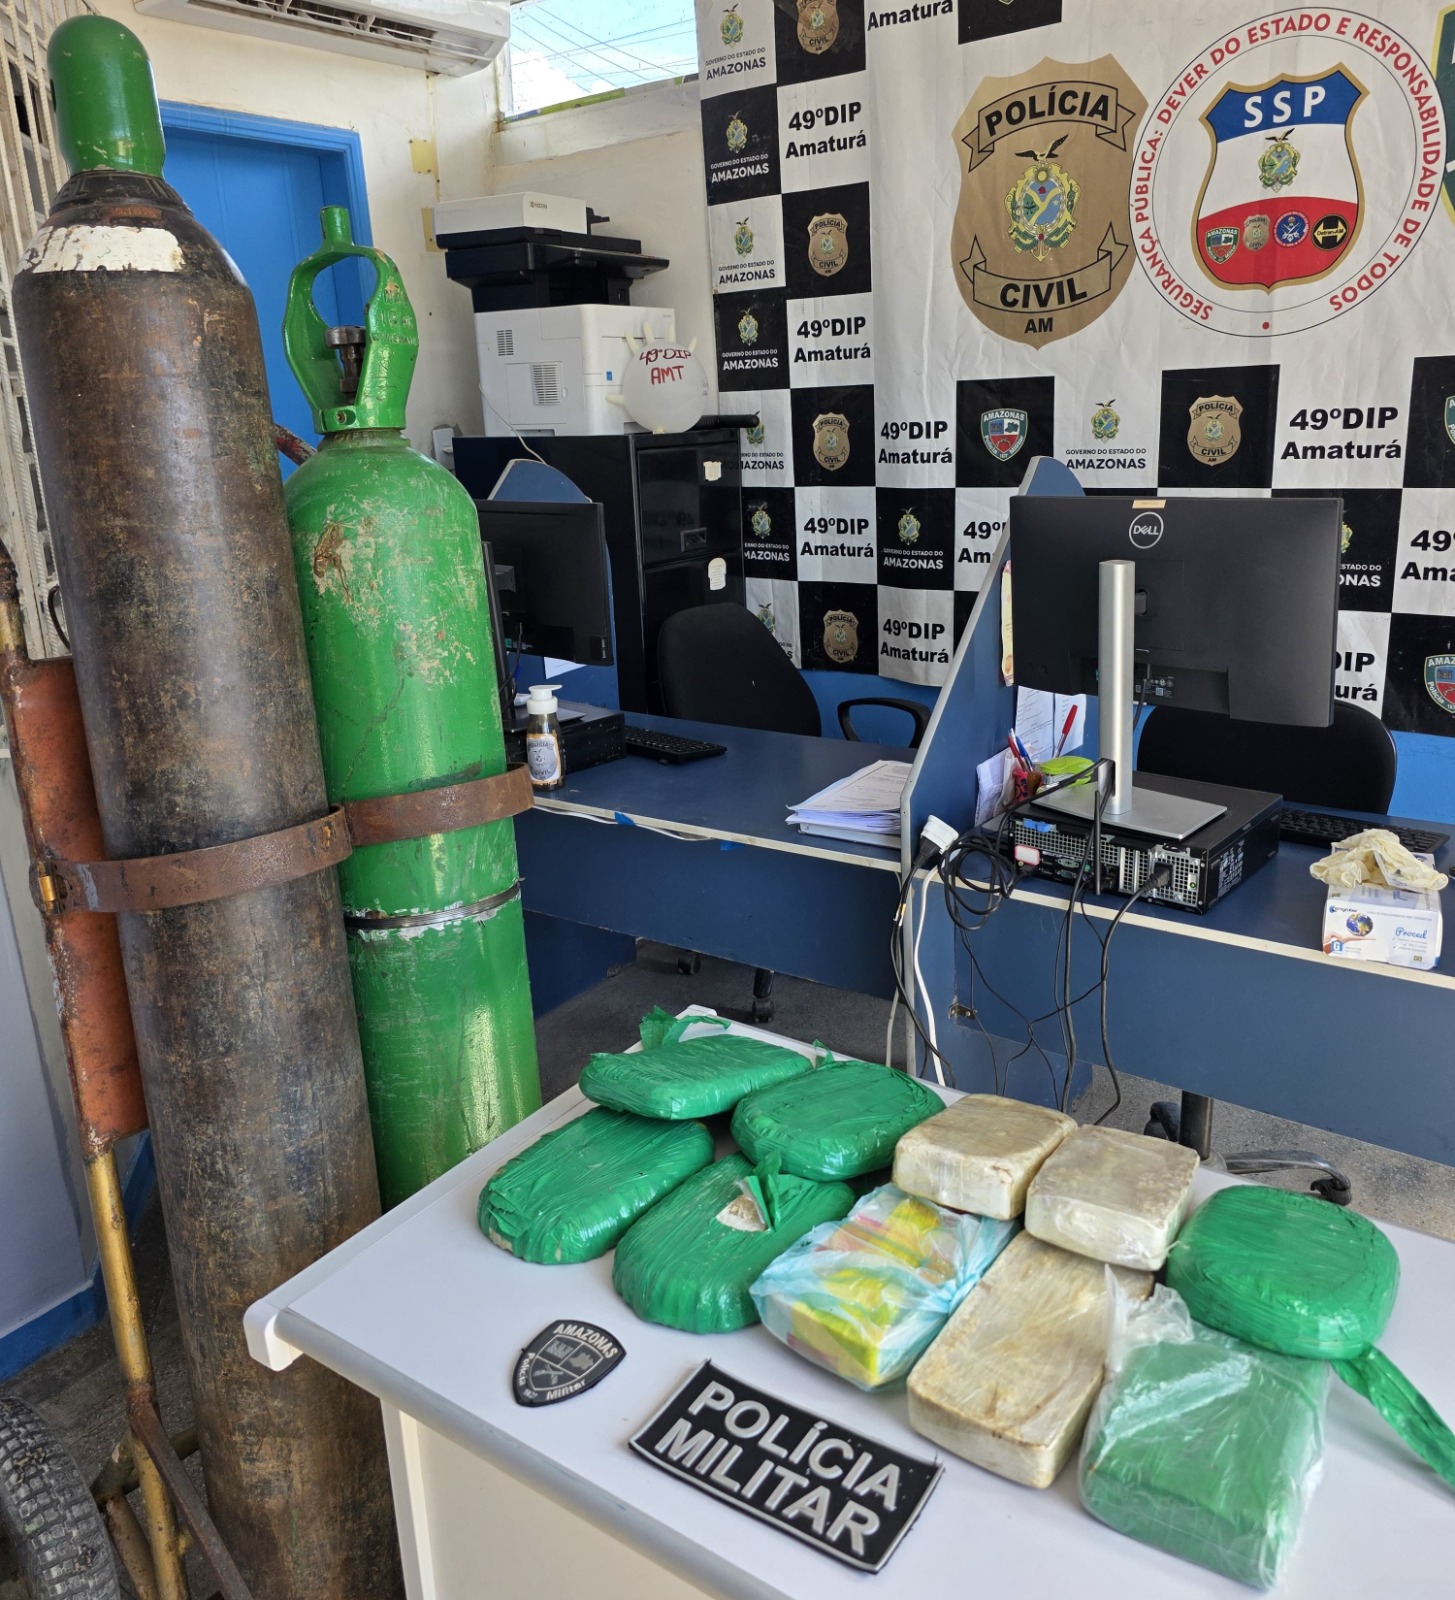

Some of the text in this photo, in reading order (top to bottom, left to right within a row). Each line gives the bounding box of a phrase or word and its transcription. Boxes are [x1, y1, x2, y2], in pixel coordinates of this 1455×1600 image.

[1247, 12, 1331, 45] ESTADO
[1336, 16, 1352, 36] E
[809, 35, 830, 46] CIVIL
[1210, 36, 1241, 66] DO
[706, 54, 726, 66] GOVERNO
[728, 52, 736, 60] DO
[736, 48, 757, 59] ESTADO
[706, 56, 766, 80] AMAZONAS
[1157, 63, 1209, 125] DEVER
[788, 101, 862, 131] 49ºDIP
[985, 85, 1109, 138] POLÍCIA
[1244, 85, 1326, 128] SSP
[1353, 21, 1441, 212] RESPONSABILIDADE
[785, 129, 866, 158] Amaturá
[710, 158, 732, 170] GOVERNO
[740, 154, 760, 165] ESTADO
[711, 162, 770, 184] AMAZONAS
[814, 218, 842, 230] POLÍCIA
[1393, 217, 1421, 248] DE
[819, 260, 838, 268] CIVIL
[1139, 229, 1214, 320] SEGURANÇA
[719, 269, 775, 284] AMAZONAS
[1328, 251, 1400, 312] TODOS
[1000, 278, 1088, 309] CIVIL
[797, 316, 866, 338] 49ºDIP
[1024, 317, 1054, 334] AM
[794, 342, 871, 363] Amaturá
[723, 358, 778, 370] AMAZONAS
[650, 366, 684, 386] AMT
[984, 410, 1025, 422] AMAZONAS
[1199, 401, 1234, 413] POLÍCIA
[820, 418, 844, 427] POLÍCIA
[1290, 407, 1399, 431] 49ºDIP
[880, 420, 948, 440] 49ºDIP
[878, 447, 952, 464] Amaturá
[1201, 447, 1226, 456] CIVIL
[1280, 439, 1402, 460] Amaturá
[1066, 458, 1146, 469] AMAZONAS
[803, 517, 869, 535] 49ºDIP
[1133, 525, 1159, 535] DELL
[800, 541, 874, 558] Amaturá
[883, 556, 944, 570] AMAZONAS
[883, 618, 945, 640] 49ºDIP
[880, 642, 949, 664] Amaturá
[1428, 681, 1445, 704] Polícia
[1395, 926, 1428, 939] Proced
[1334, 942, 1340, 951] G
[553, 1323, 619, 1359] AMAZONAS
[518, 1352, 586, 1400] Polícia Militar
[687, 1380, 901, 1512] POLÍCIA
[654, 1417, 880, 1556] MILITAR
